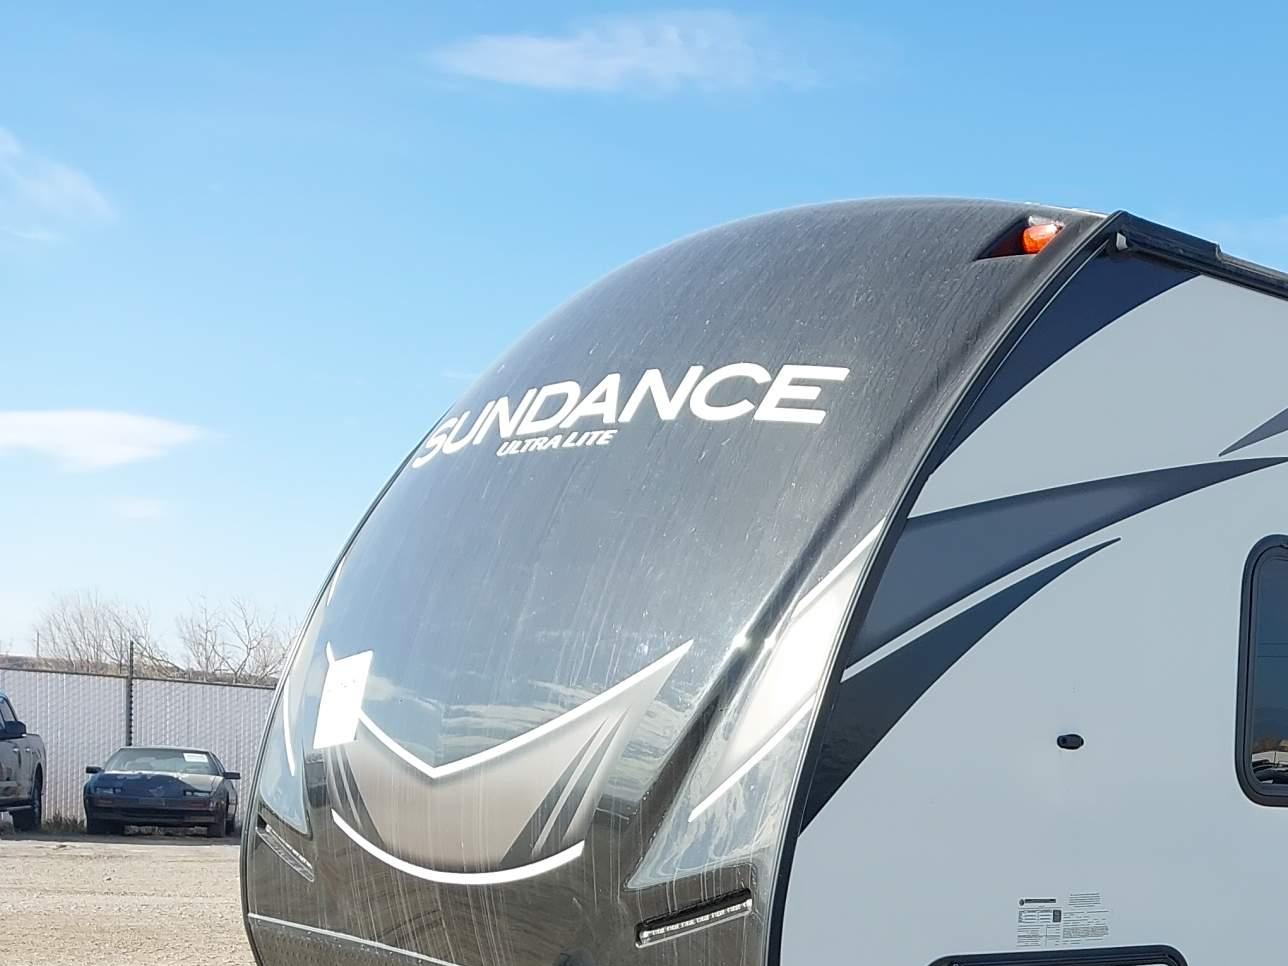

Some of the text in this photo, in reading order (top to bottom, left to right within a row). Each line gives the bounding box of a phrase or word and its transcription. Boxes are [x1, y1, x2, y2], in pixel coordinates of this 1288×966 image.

[411, 361, 851, 470] SUNDANCE
[496, 429, 619, 457] ULTRA LITE
